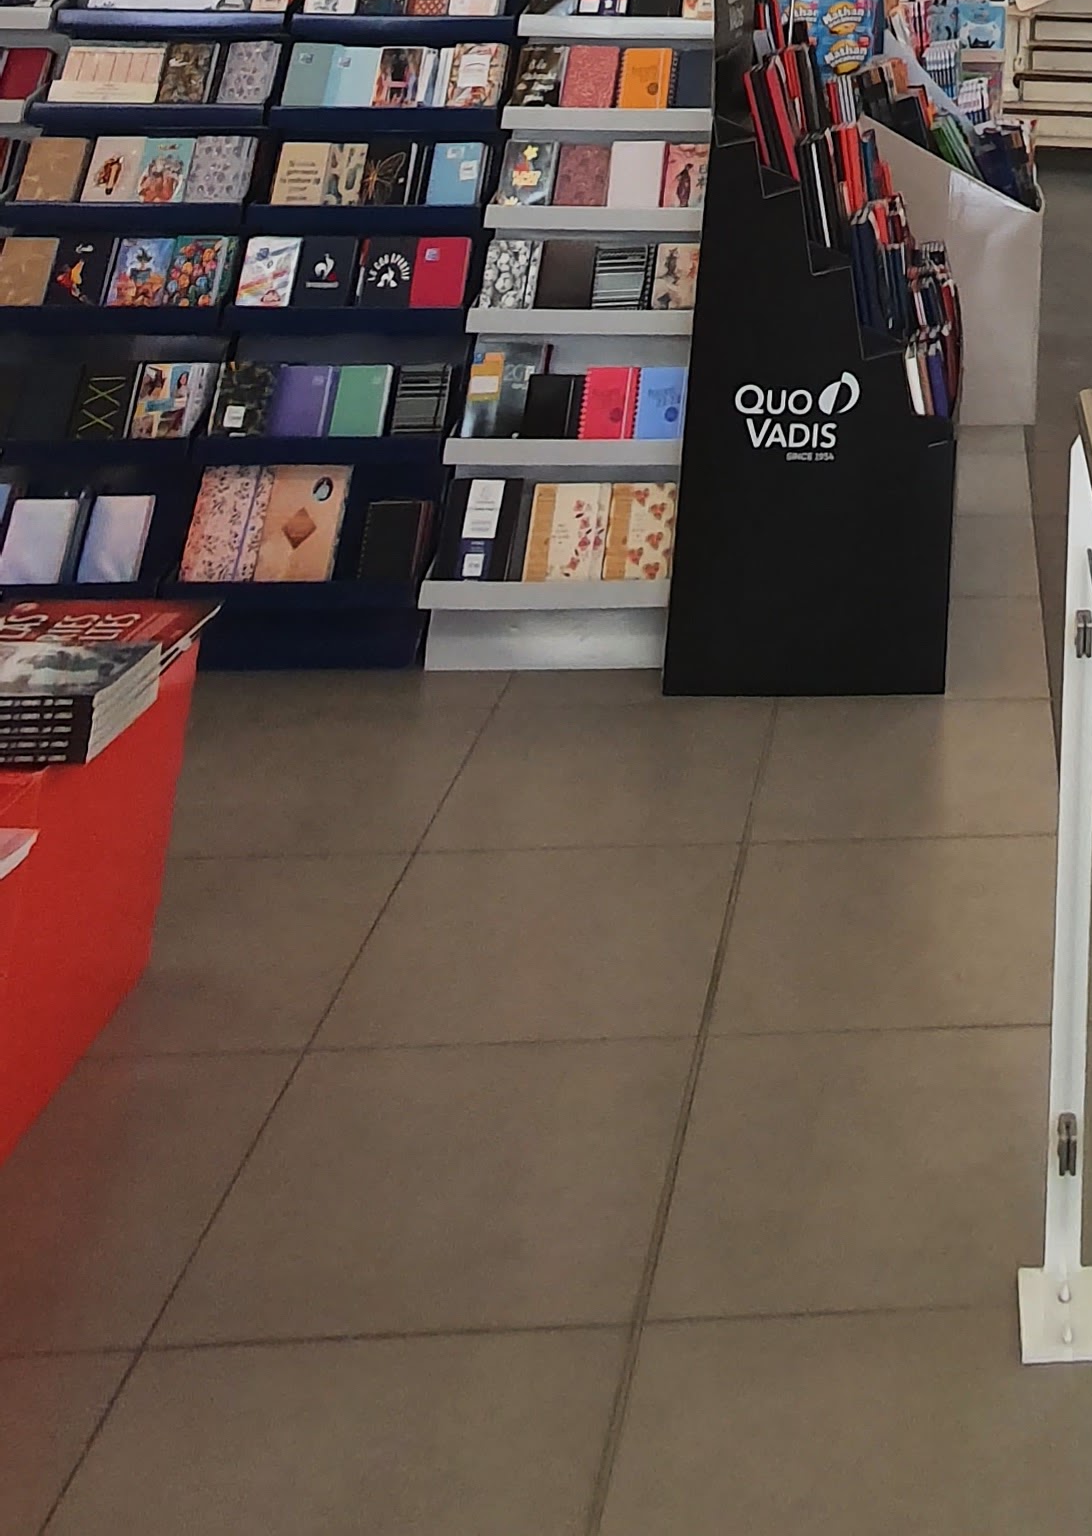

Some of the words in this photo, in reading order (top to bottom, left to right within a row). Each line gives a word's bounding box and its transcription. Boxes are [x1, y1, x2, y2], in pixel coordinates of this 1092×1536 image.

[734, 384, 813, 415] QUO
[746, 418, 838, 448] VADIS
[786, 452, 813, 461] SINCE
